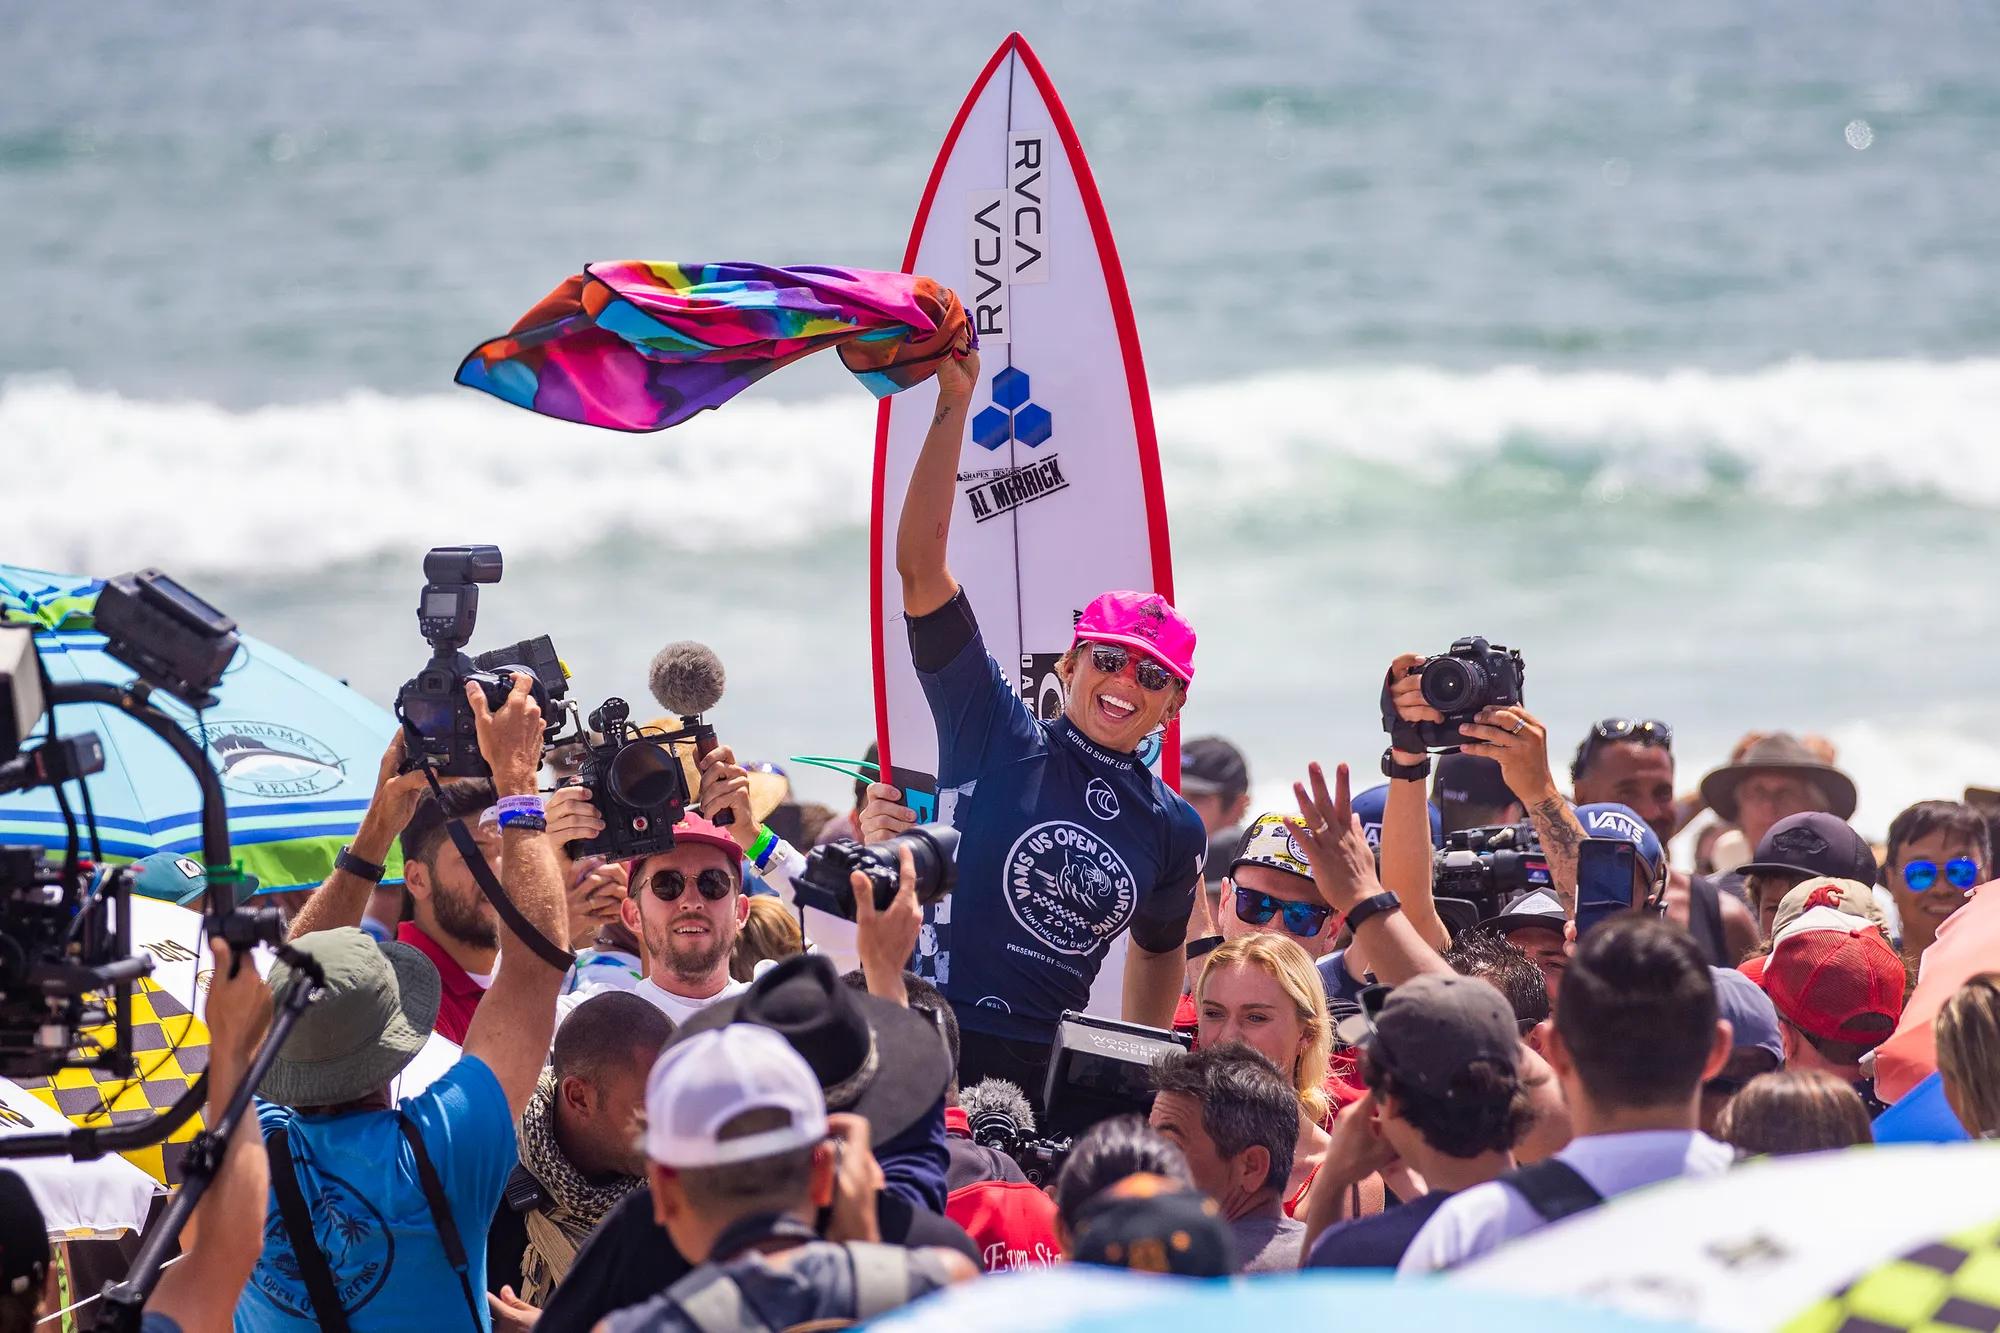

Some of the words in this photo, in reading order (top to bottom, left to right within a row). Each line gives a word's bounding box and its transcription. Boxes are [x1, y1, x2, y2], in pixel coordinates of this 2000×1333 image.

[1014, 138, 1042, 274] RVCA
[974, 199, 1003, 336] RVCA
[968, 489, 992, 519] AL
[990, 458, 1066, 510] MERRICK
[1021, 654, 1035, 712] OAK
[231, 724, 308, 746] BAHAMA
[1066, 728, 1094, 754] WORLD
[1092, 750, 1116, 766] SURF
[253, 779, 321, 794] RELAX
[1028, 832, 1054, 854] US
[1054, 827, 1098, 855] OPEN
[1587, 811, 1646, 845] VANS
[1013, 851, 1035, 900] VANS
[1099, 852, 1121, 874] OF
[1090, 876, 1131, 935] SURFING
[1021, 906, 1068, 946] HUNTINGTON
[1006, 943, 1046, 961] PRESENTED
[1046, 956, 1055, 965] BY
[1088, 1033, 1160, 1053] WOODEN
[1094, 1041, 1156, 1058] CAMERA
[263, 1274, 295, 1304] OPEN
[300, 1297, 312, 1312] O
[337, 1261, 379, 1305] URFING
